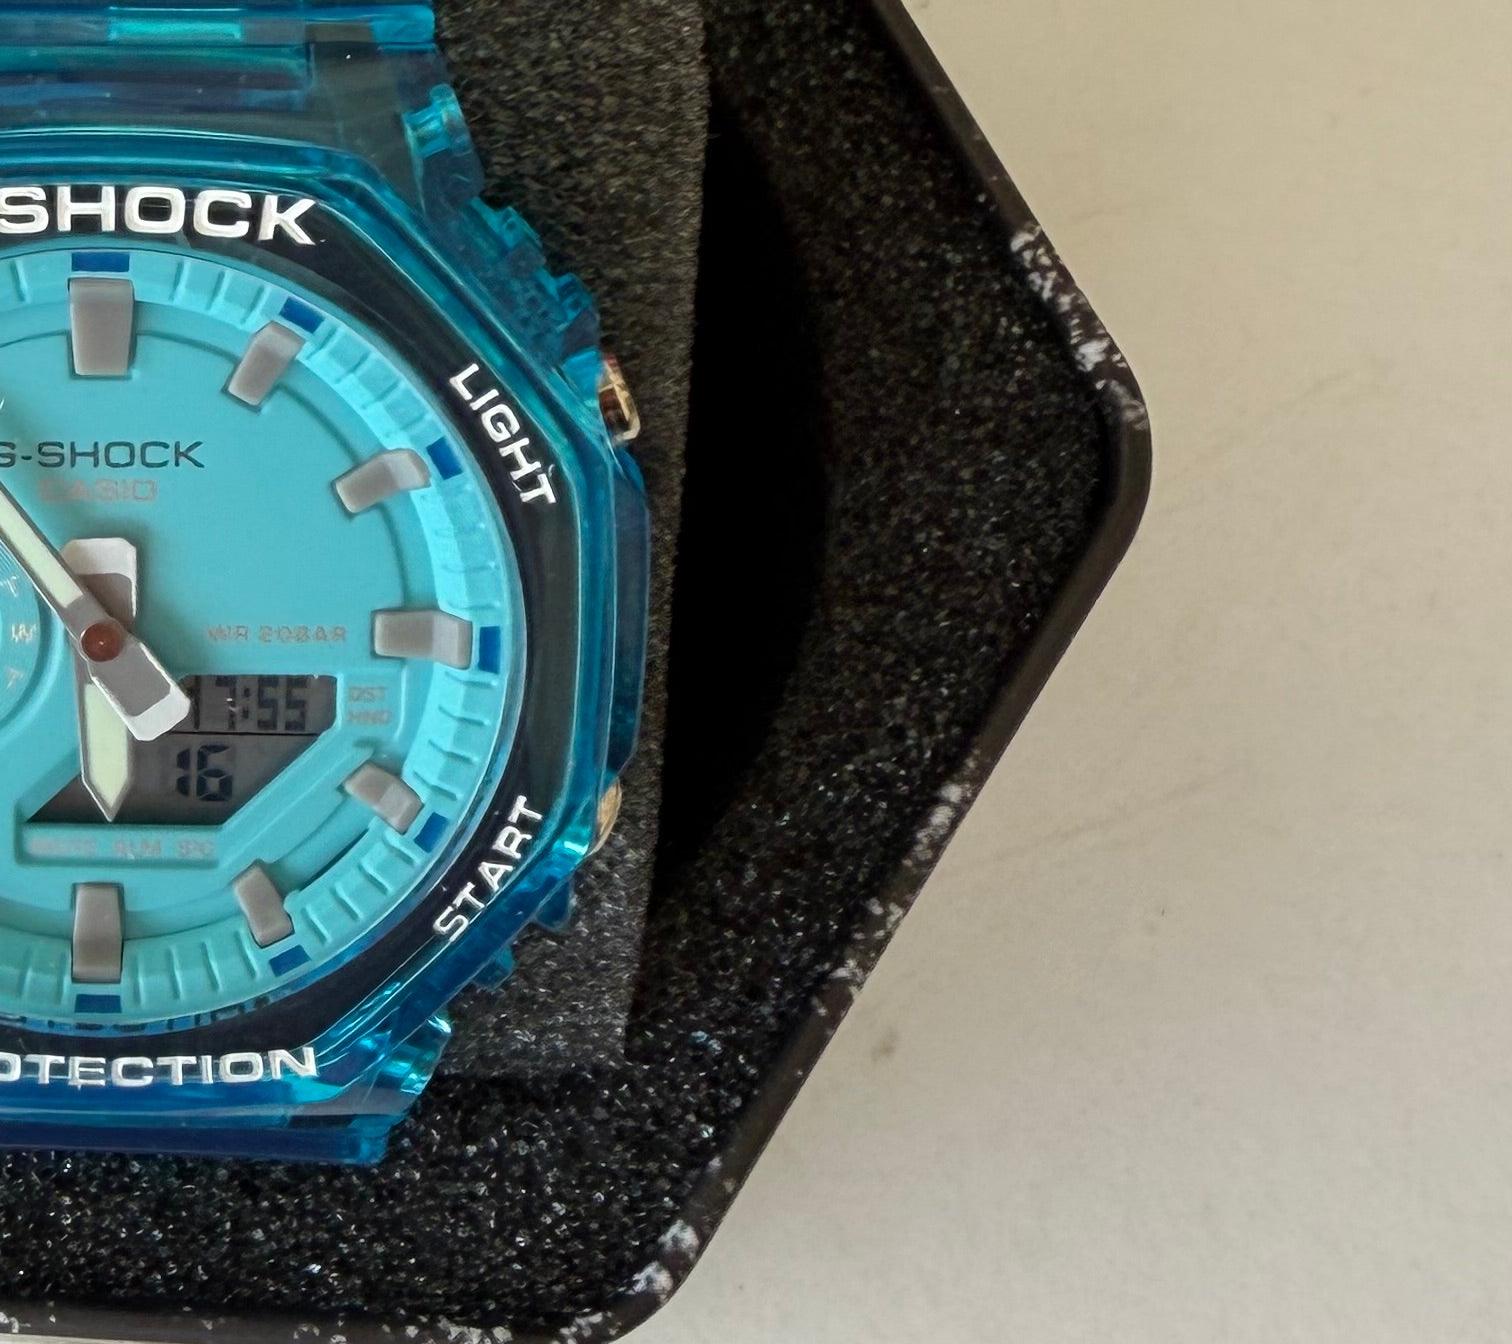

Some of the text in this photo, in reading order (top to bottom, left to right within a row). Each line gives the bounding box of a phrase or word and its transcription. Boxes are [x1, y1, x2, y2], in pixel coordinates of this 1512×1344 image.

[448, 362, 557, 504] LIGHT
[175, 743, 234, 803] 16
[432, 794, 544, 943] START
